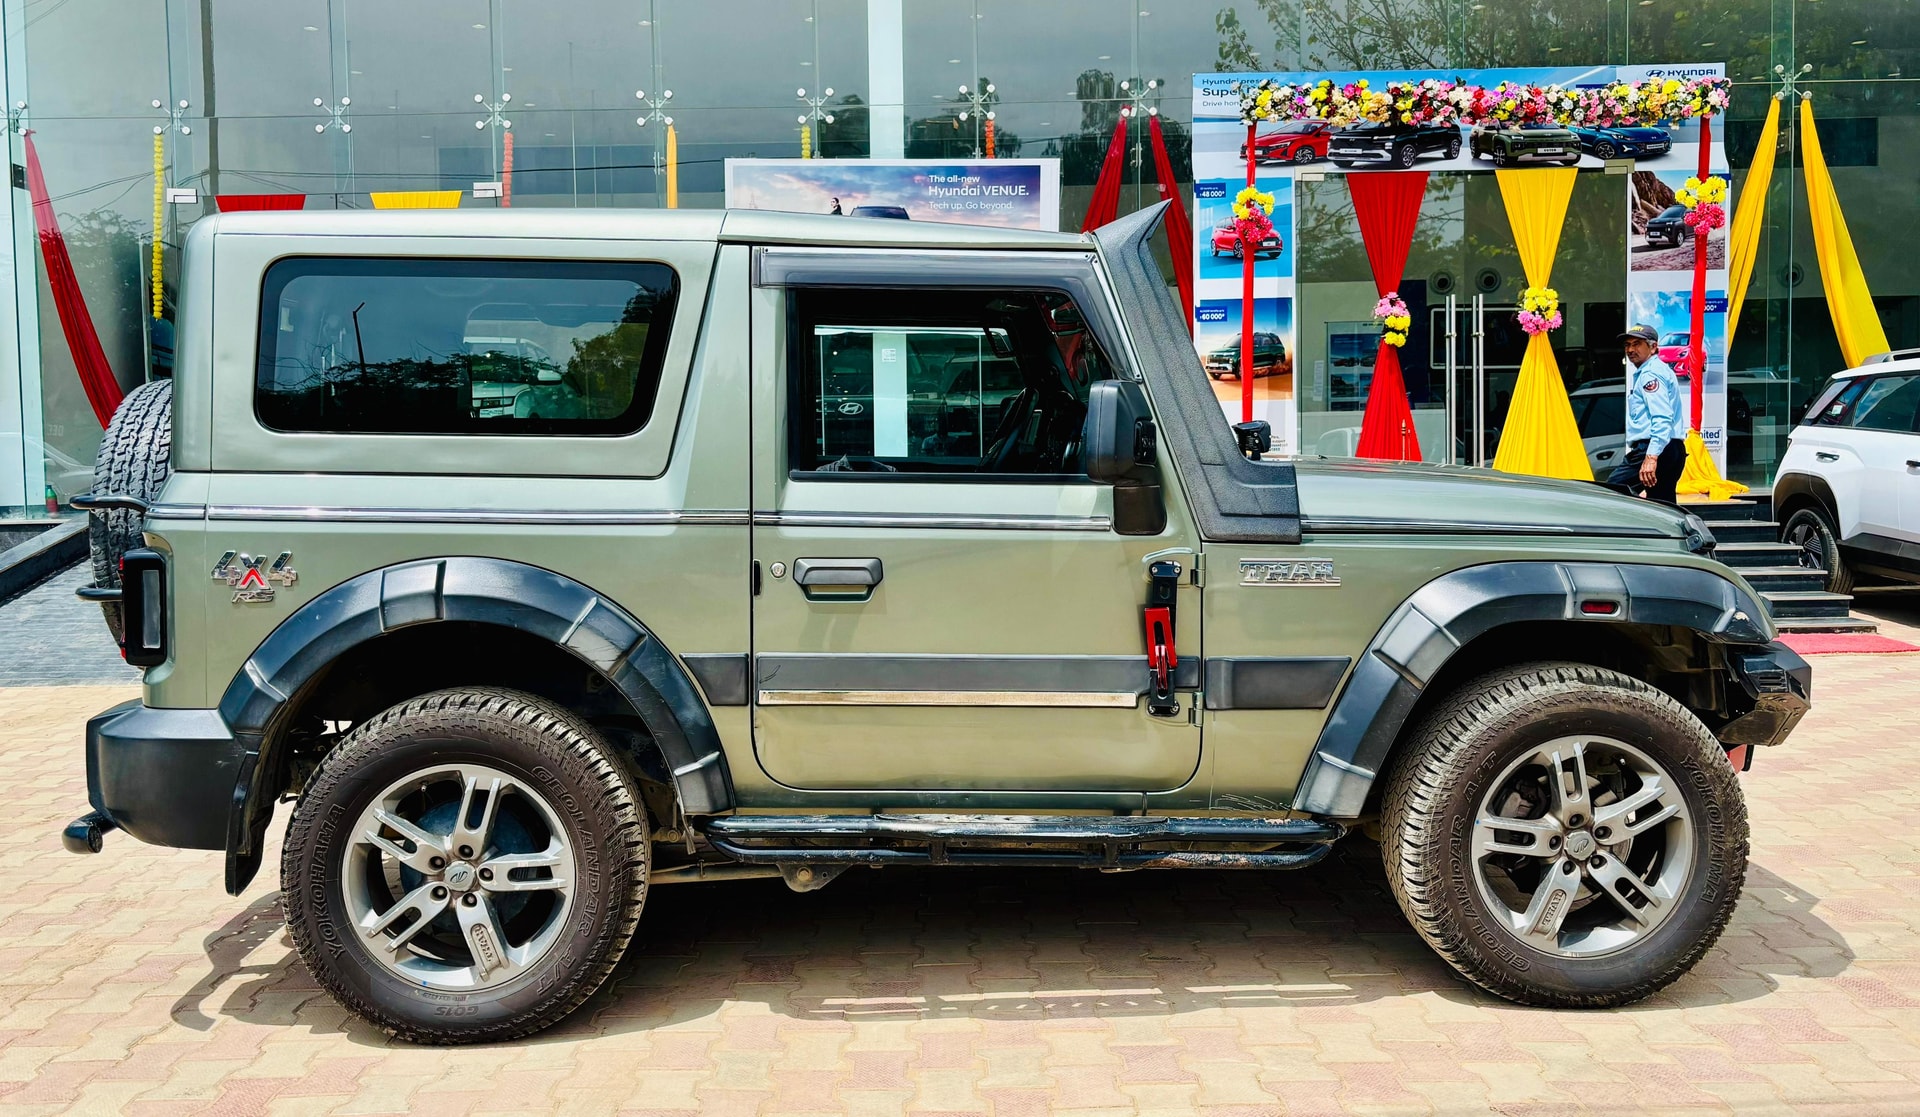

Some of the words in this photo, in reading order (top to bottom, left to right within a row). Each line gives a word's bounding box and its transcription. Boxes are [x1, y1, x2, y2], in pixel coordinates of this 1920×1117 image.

[928, 174, 946, 183] The
[947, 174, 980, 183] all-new
[928, 185, 980, 198] Hyundai
[982, 185, 1030, 196] VENUE.
[928, 201, 949, 210] Tech
[950, 202, 964, 211] up.
[965, 201, 979, 210] Go
[980, 201, 1015, 211] beyond.
[1239, 559, 1341, 585] THAR
[532, 765, 600, 938] GEOLANDAR
[1680, 753, 1728, 905] YOKOHAMA
[309, 802, 346, 961] YOKOHAMA
[1450, 814, 1533, 973] GEOLANDAR
